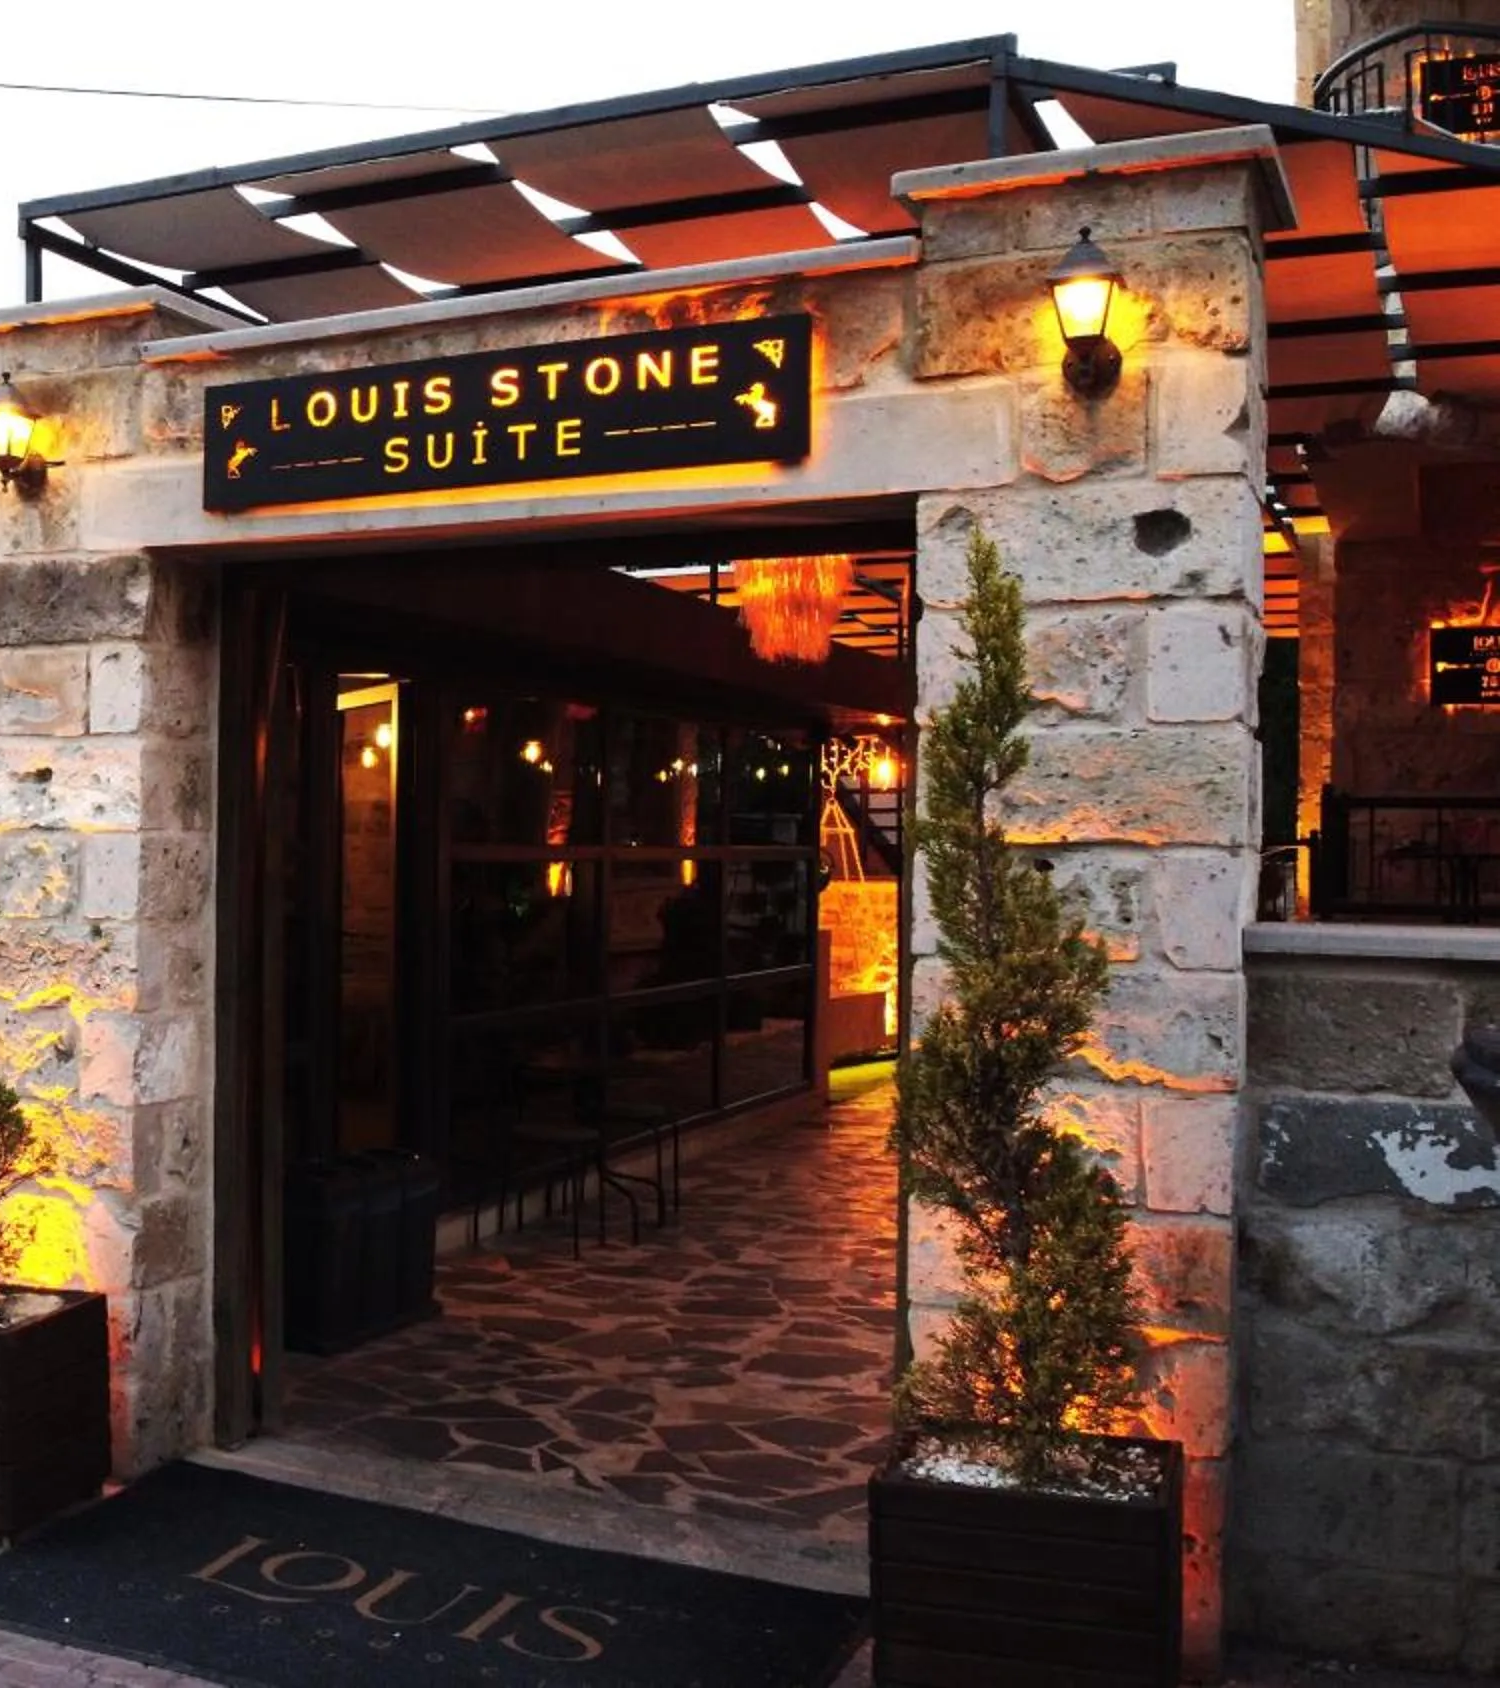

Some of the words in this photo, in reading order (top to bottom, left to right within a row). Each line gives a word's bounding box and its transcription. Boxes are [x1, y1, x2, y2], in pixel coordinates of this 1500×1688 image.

[270, 375, 453, 431] LOUIS
[490, 344, 720, 408] STONE
[187, 1534, 620, 1662] LOUIS
